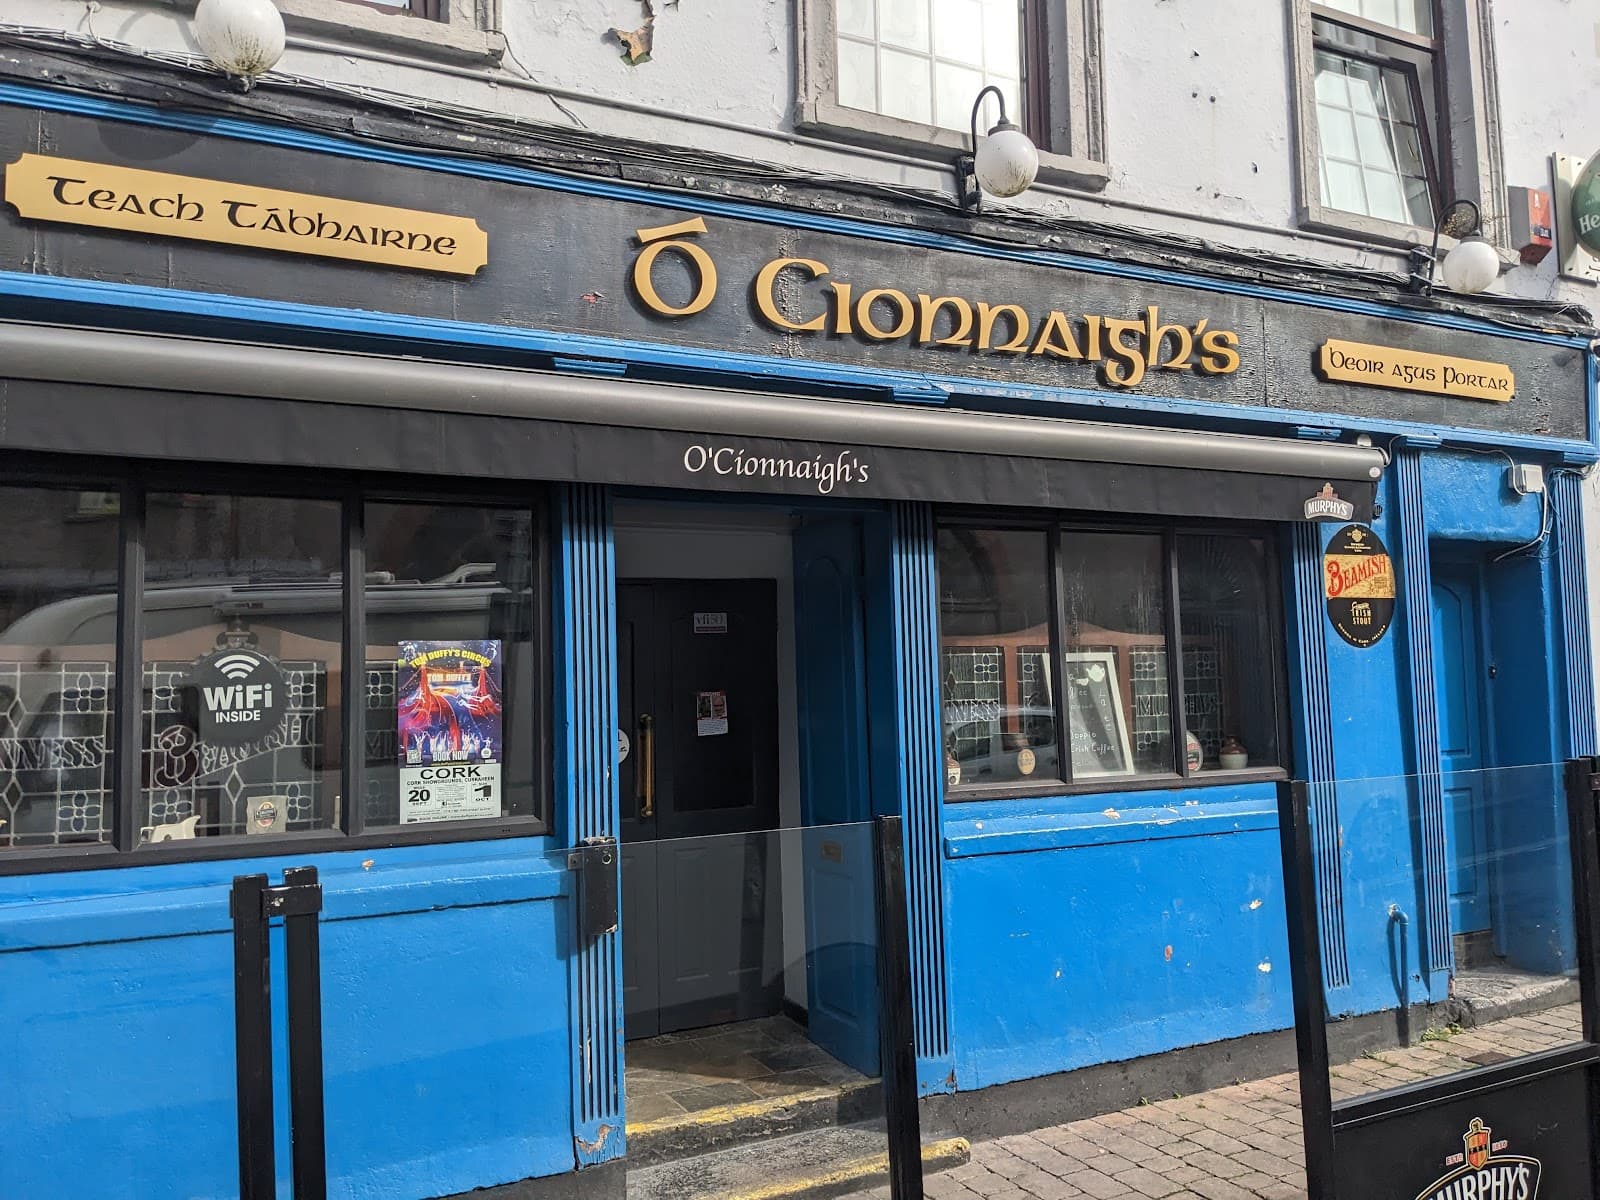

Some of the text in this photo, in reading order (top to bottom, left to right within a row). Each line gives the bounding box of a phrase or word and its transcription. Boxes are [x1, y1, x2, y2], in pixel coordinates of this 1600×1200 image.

[47, 175, 457, 256] Teach Tábhairne
[633, 216, 717, 316] Ó
[1353, 617, 1372, 625] STOUT
[409, 648, 492, 668] TOM DUFFY'S CIRCUS
[203, 683, 273, 711] WiFi
[215, 710, 261, 724] INSIDE
[432, 750, 451, 762] BOOK
[452, 749, 470, 761] NOW
[420, 766, 481, 780] CORK
[408, 789, 431, 802] 20
[474, 785, 492, 798] 1
